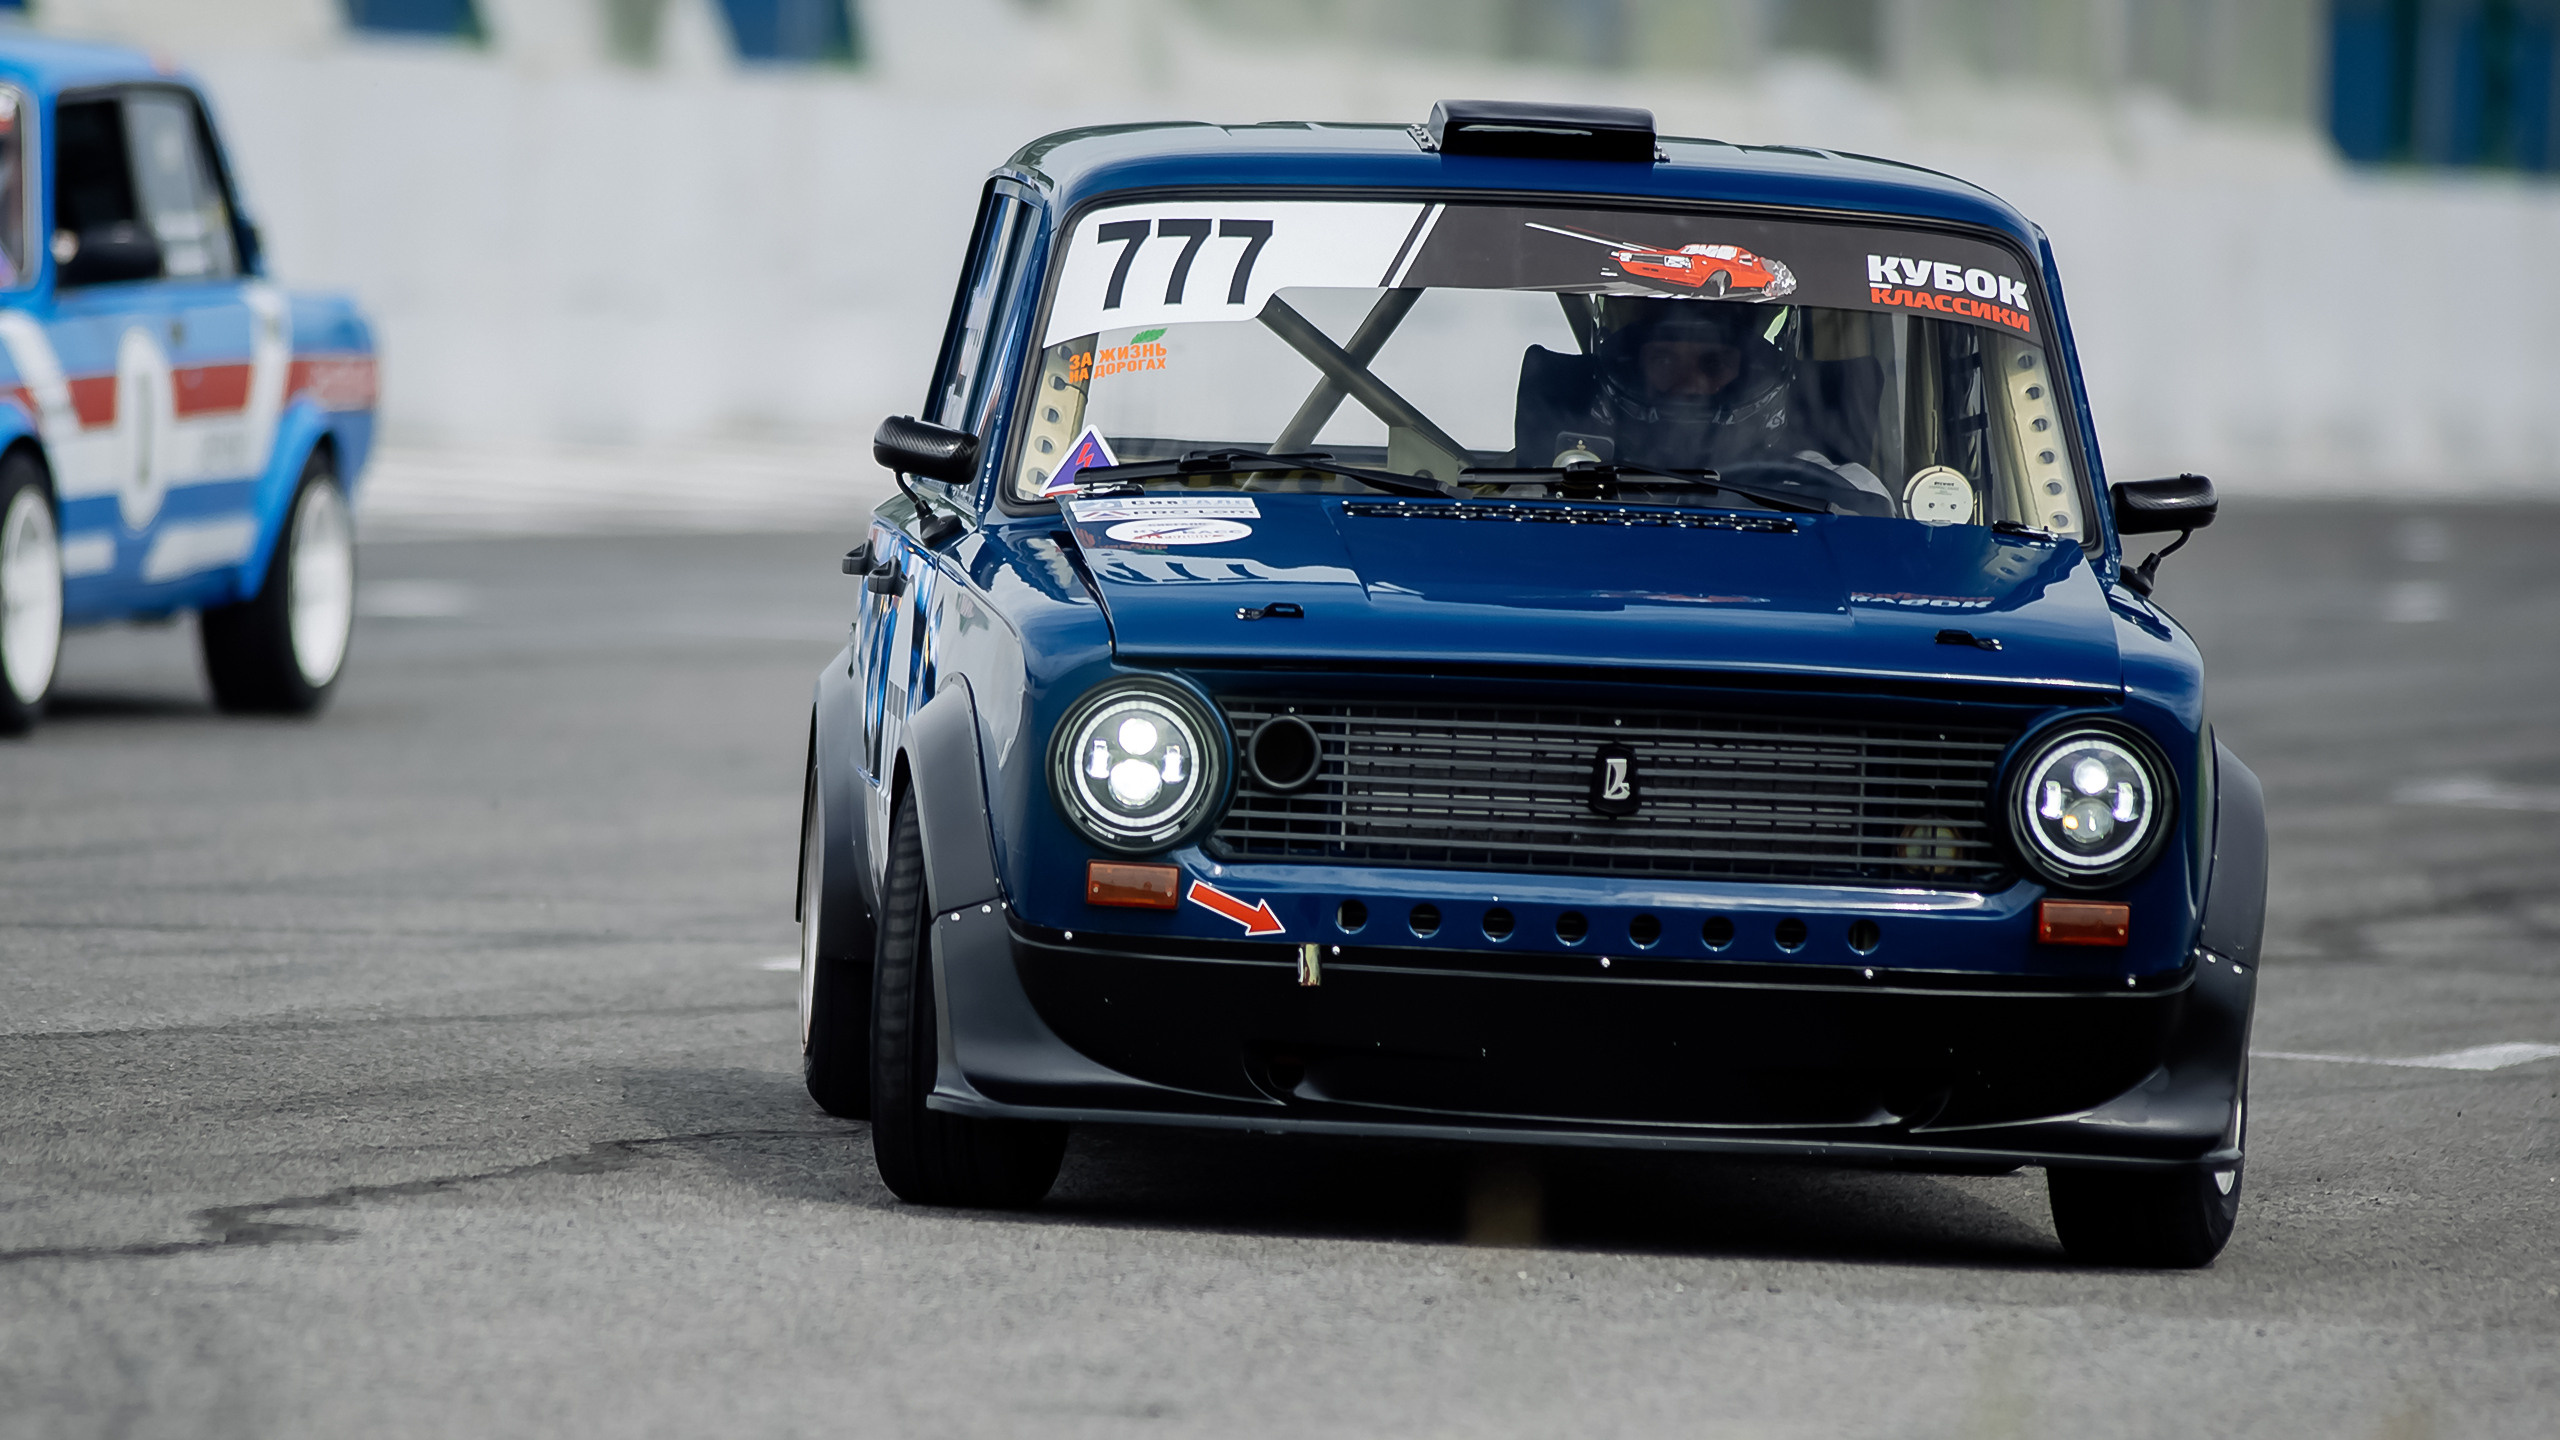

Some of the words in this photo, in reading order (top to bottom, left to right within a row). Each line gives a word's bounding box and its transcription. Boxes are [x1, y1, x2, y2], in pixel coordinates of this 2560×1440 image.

[1097, 218, 1274, 311] 777
[1866, 253, 2030, 312] КУБОК
[1869, 287, 2031, 334] КЛАССИКИ
[1068, 367, 1090, 384] НА
[1093, 357, 1167, 380] ДОРОГАХ
[1069, 351, 1093, 370] ЗА
[1098, 343, 1168, 363] ЖИЗНЬ
